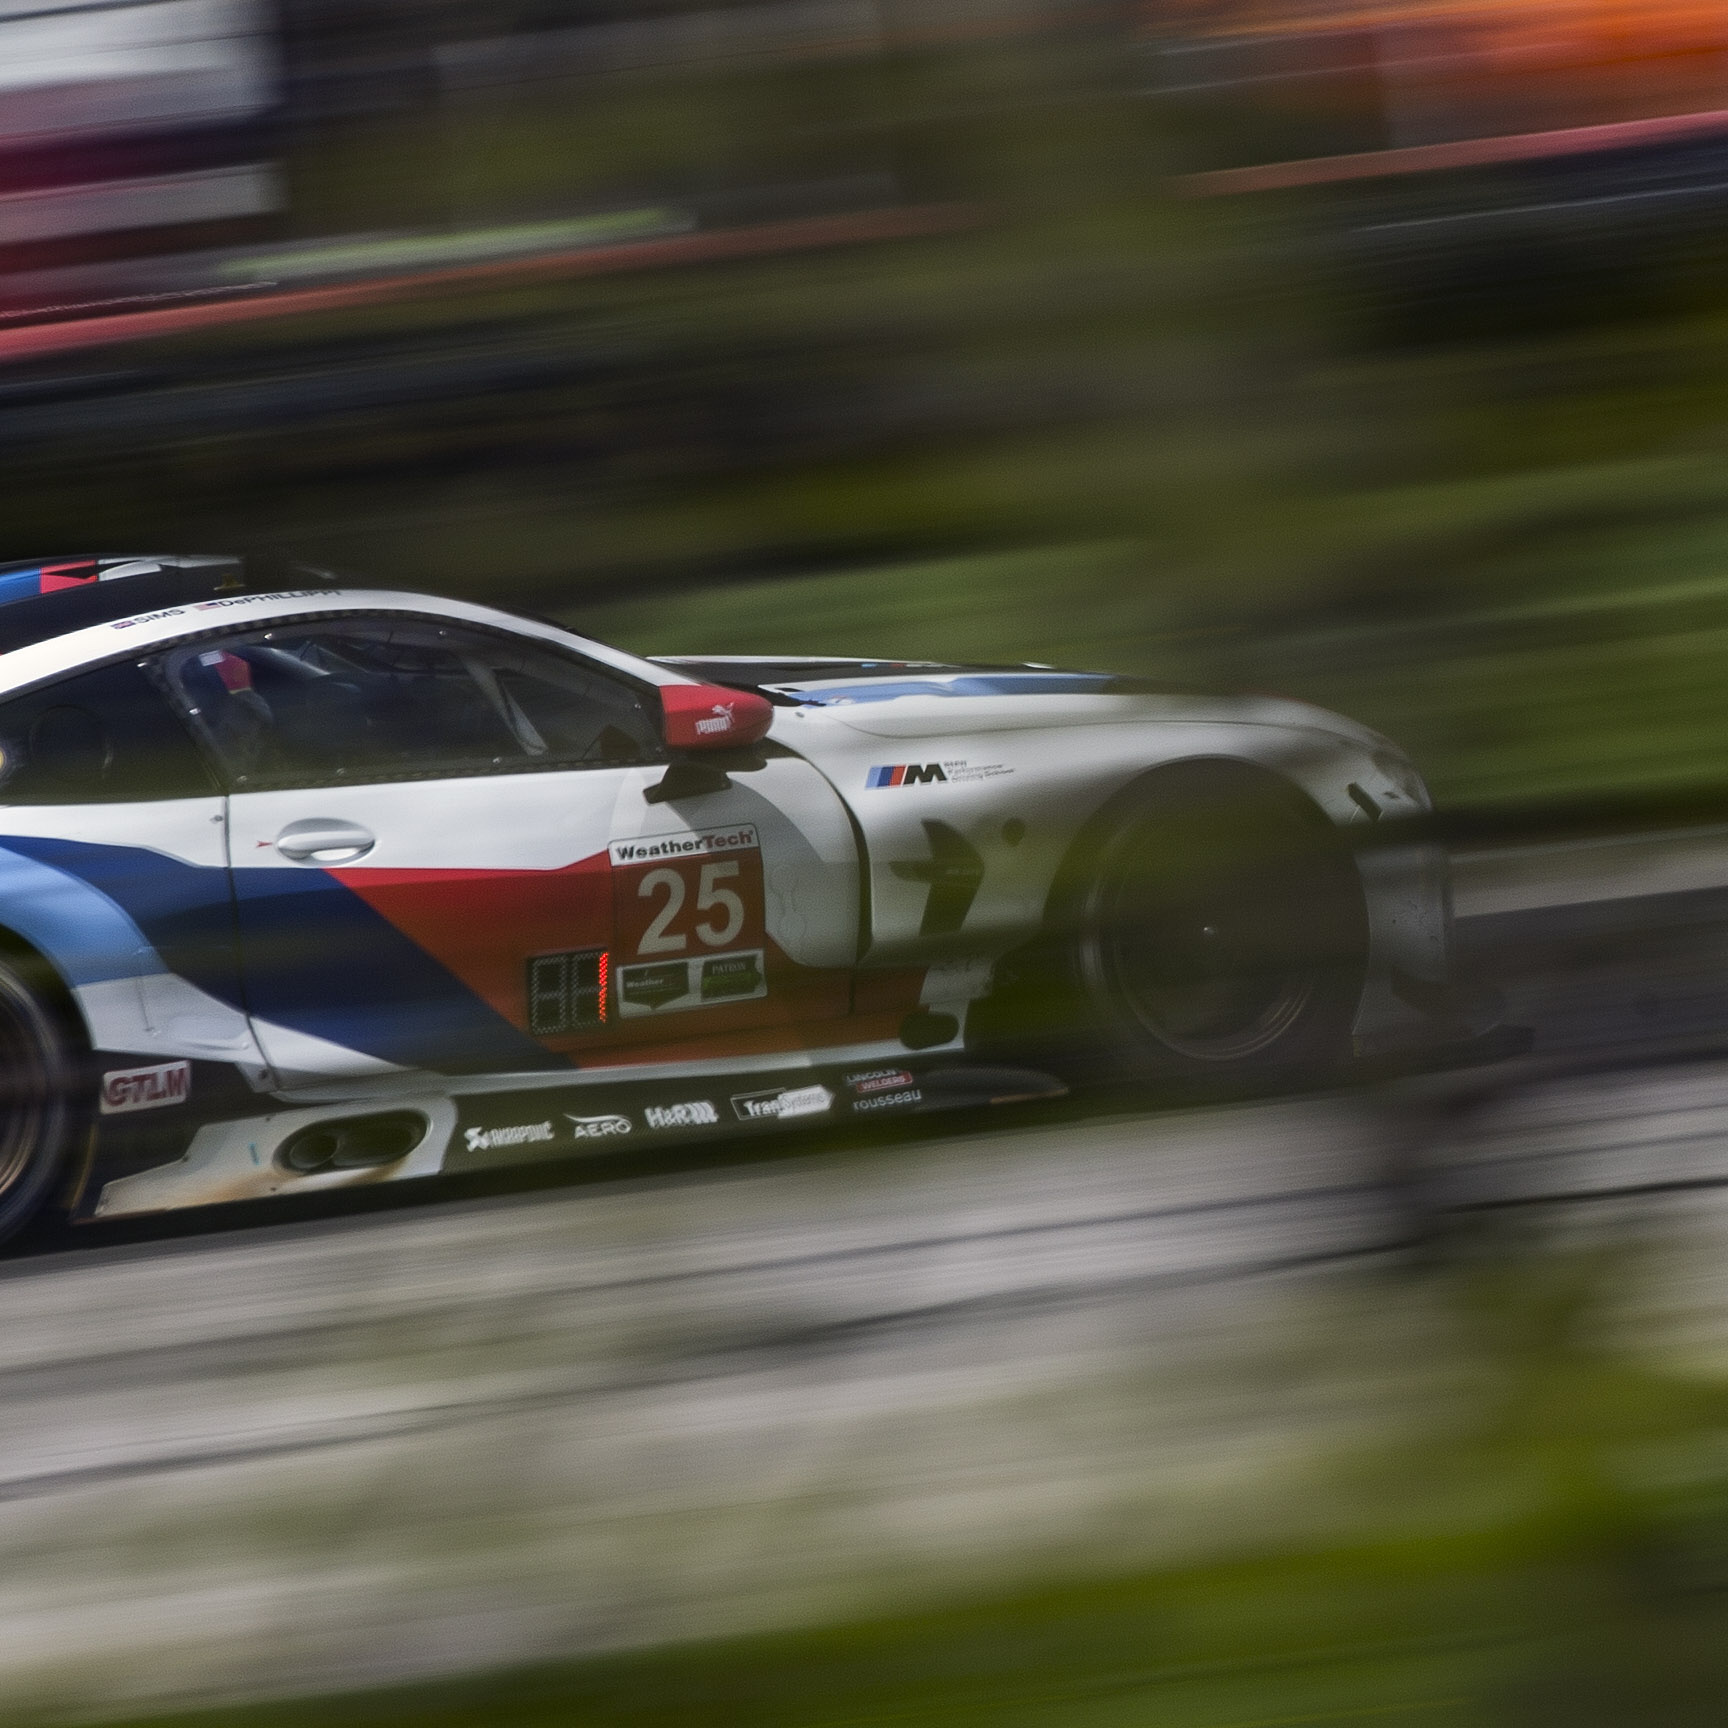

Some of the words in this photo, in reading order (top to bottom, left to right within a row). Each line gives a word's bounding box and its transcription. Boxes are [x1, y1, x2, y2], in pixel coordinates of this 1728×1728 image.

[133, 608, 186, 624] SIMS
[615, 829, 753, 861] WeatherTech
[636, 860, 745, 956] 25
[104, 1067, 188, 1107] GTLM
[853, 1089, 922, 1111] rousseau
[575, 1120, 632, 1139] AERO
